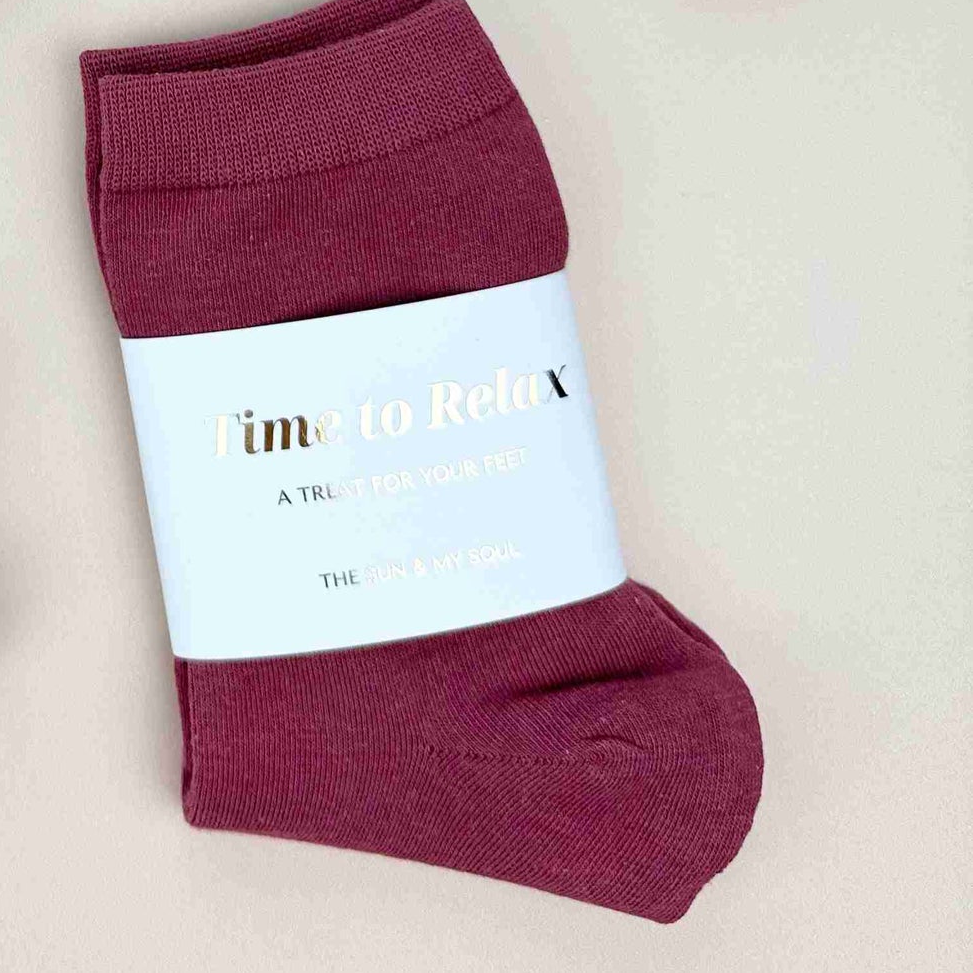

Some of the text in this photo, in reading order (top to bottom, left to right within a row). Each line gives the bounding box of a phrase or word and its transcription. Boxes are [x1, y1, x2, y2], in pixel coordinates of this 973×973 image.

[205, 364, 569, 457] Time to Relax
[278, 490, 292, 505] A
[371, 471, 414, 495] FOR
[420, 460, 479, 486] YOUR
[483, 446, 527, 472] FEET
[319, 570, 360, 589] THE
[413, 557, 428, 576] &
[432, 551, 465, 572] MY
[468, 542, 521, 564] SOUL
